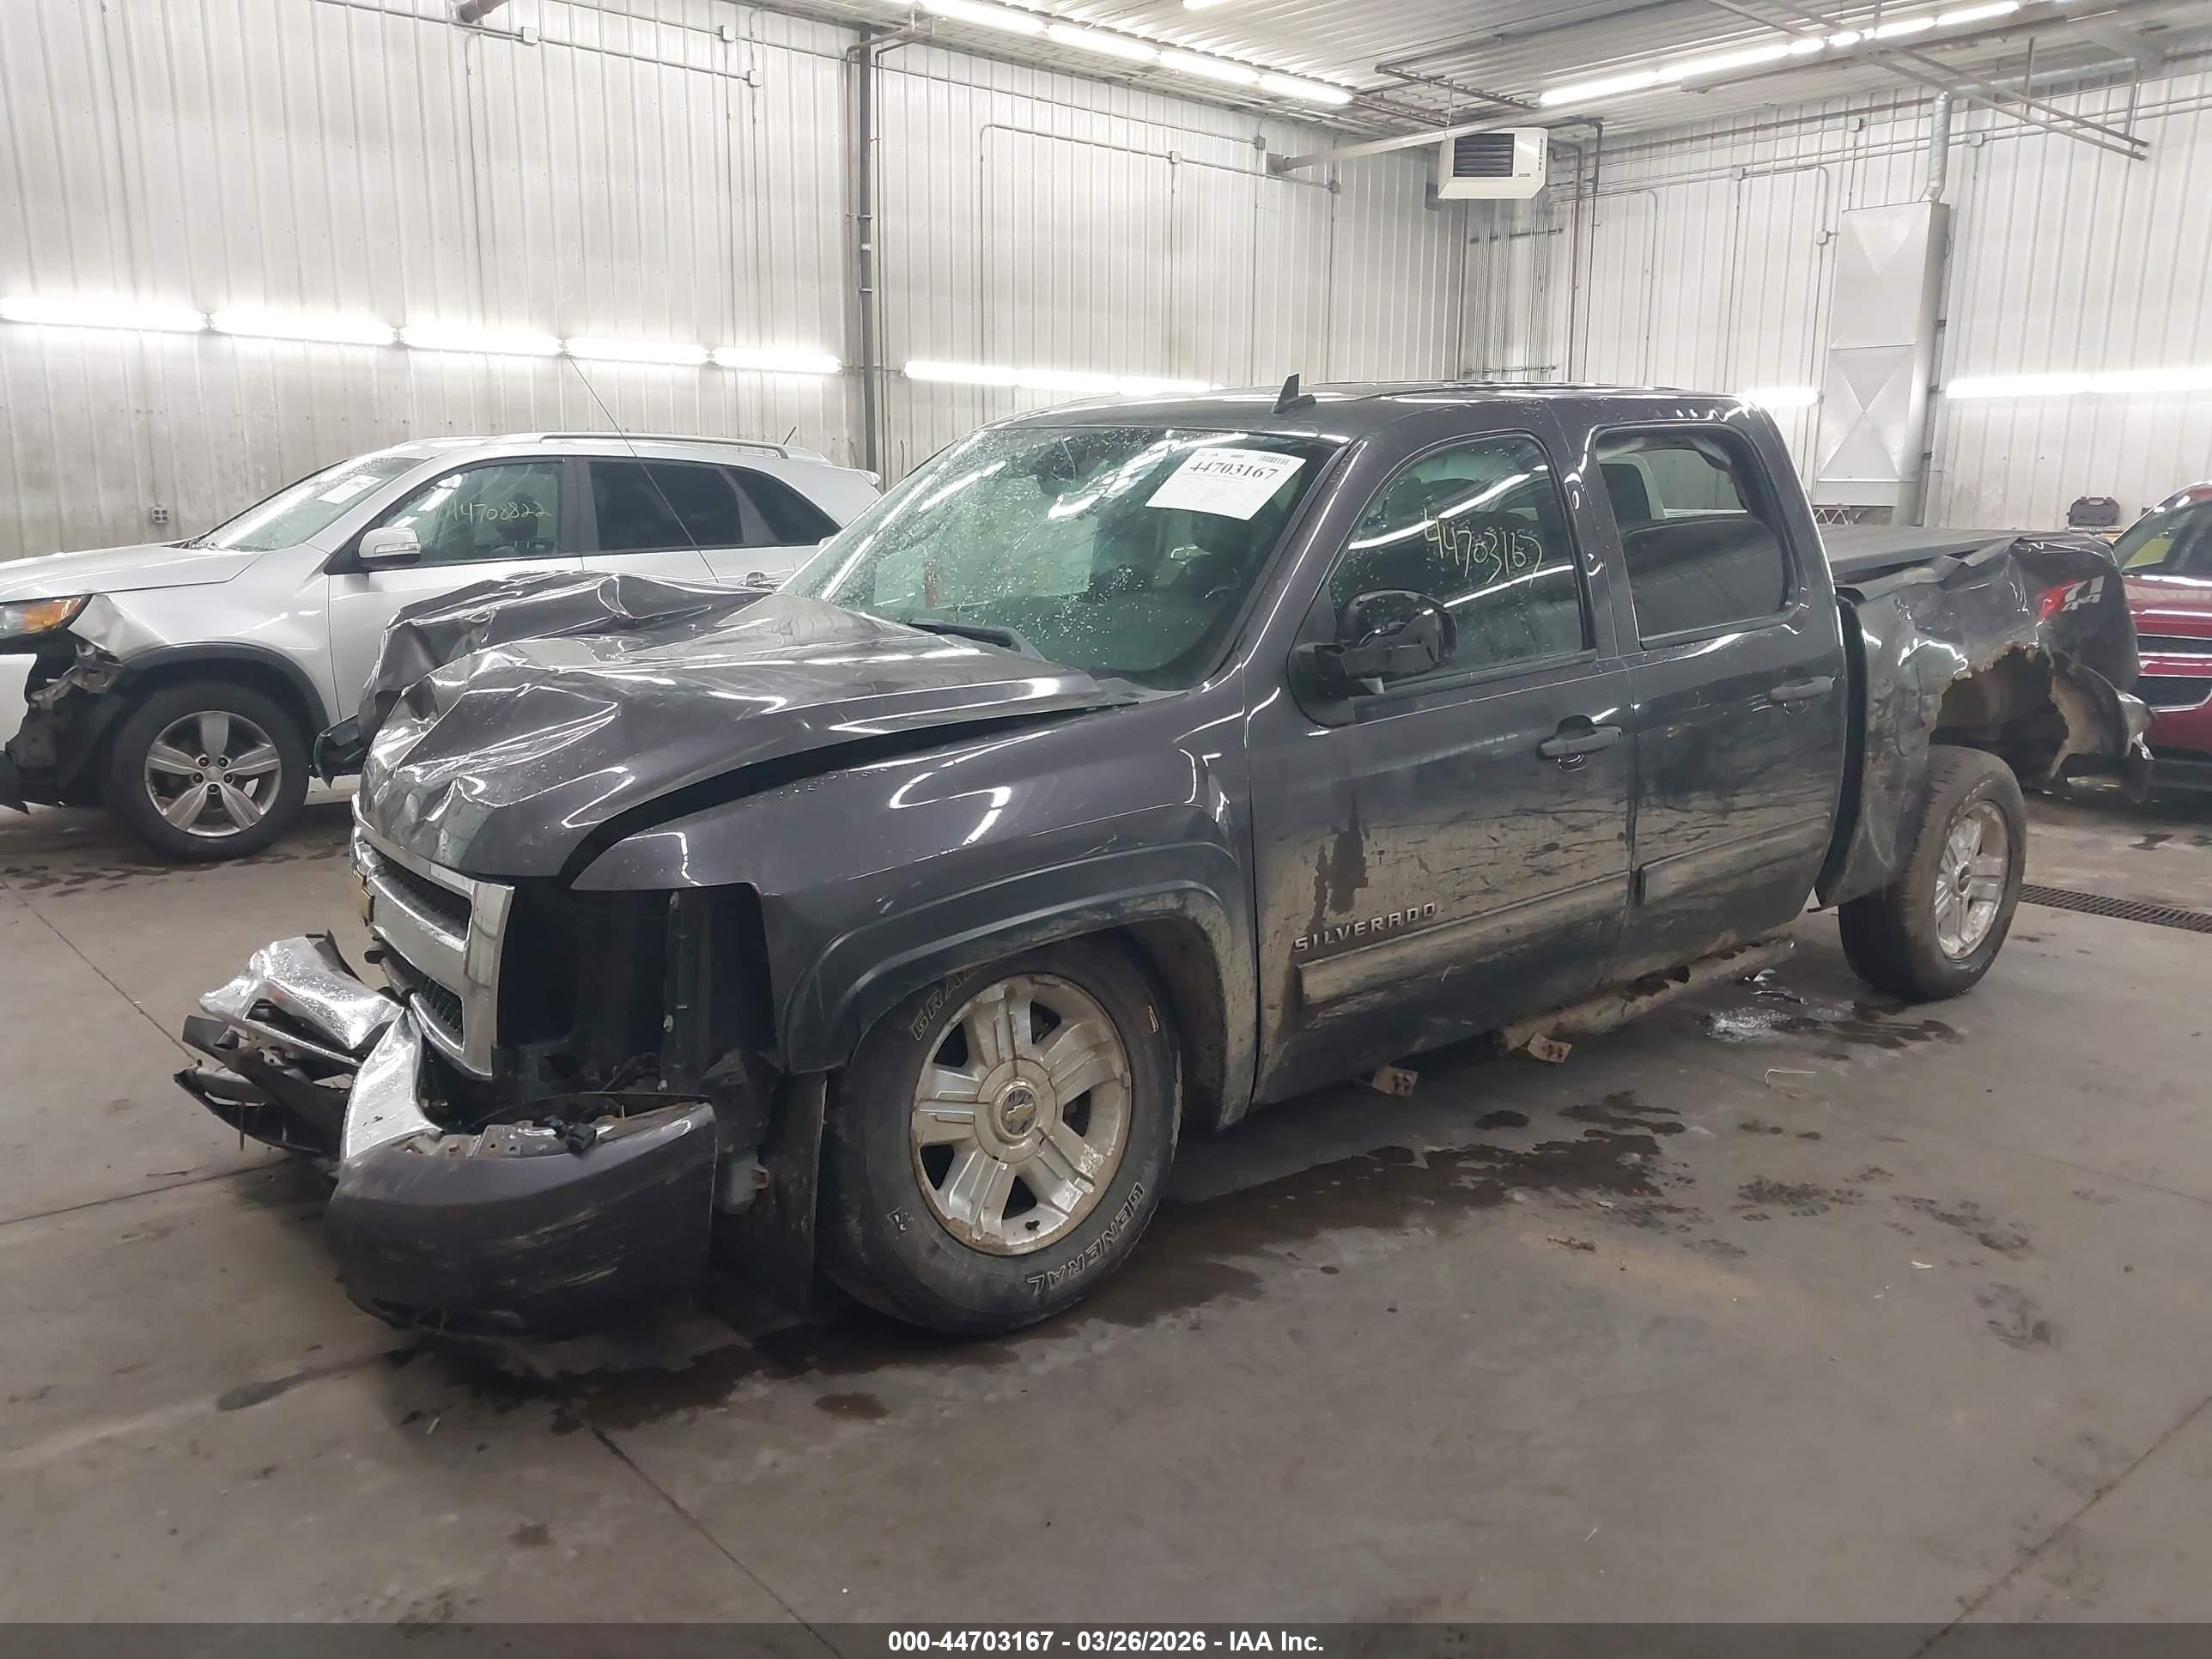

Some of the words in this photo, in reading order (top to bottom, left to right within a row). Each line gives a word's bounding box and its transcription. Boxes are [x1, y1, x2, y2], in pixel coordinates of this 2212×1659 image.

[1189, 461, 1279, 480] 44703167
[1294, 902, 1437, 953] SILVERADO
[1027, 1182, 1146, 1296] GENERAL
